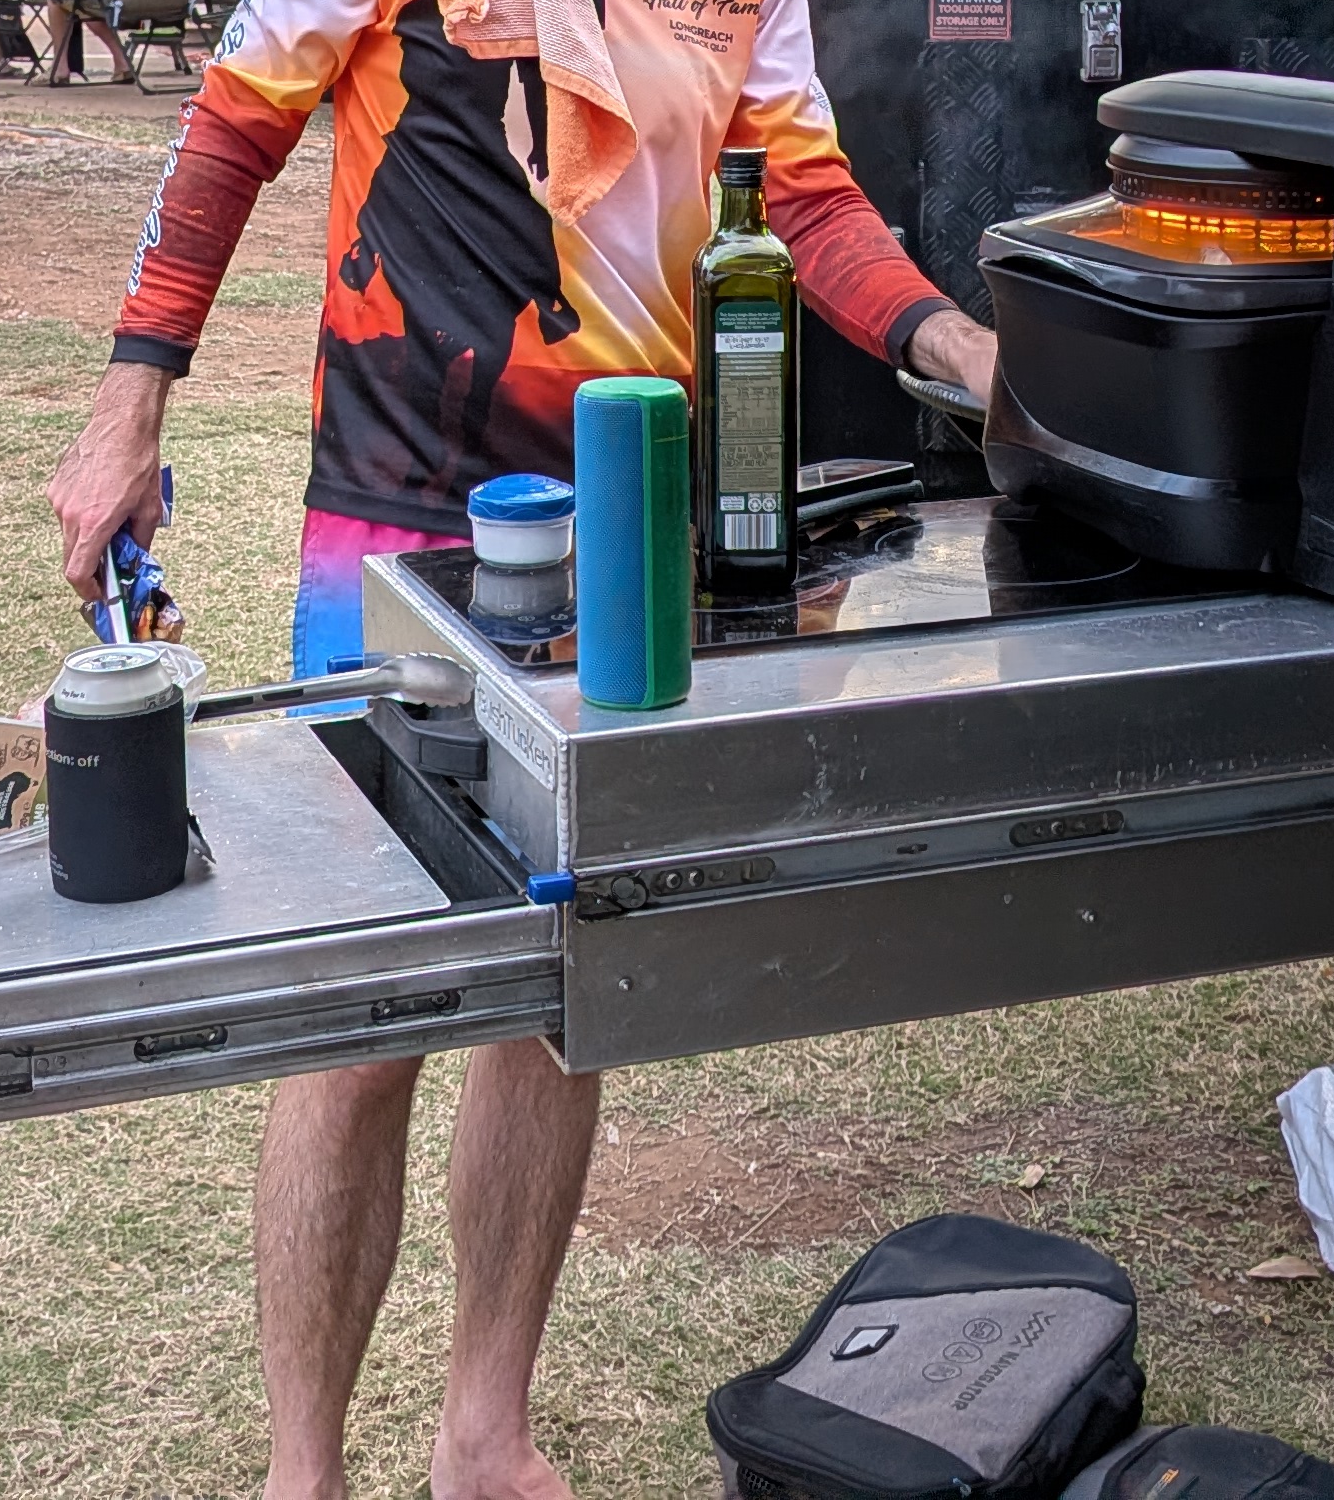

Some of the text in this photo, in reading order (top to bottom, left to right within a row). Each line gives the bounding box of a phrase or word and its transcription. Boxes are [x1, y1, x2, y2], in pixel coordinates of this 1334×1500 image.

[938, 4, 1004, 14] TOOLBOX FOR
[935, 16, 1006, 26] STORAGE ONLY
[669, 19, 734, 43] LONGREACH
[674, 32, 728, 53] OUTBACK QLD
[45, 749, 100, 767] tion: off
[951, 1351, 1020, 1411] NAVIGATOR
